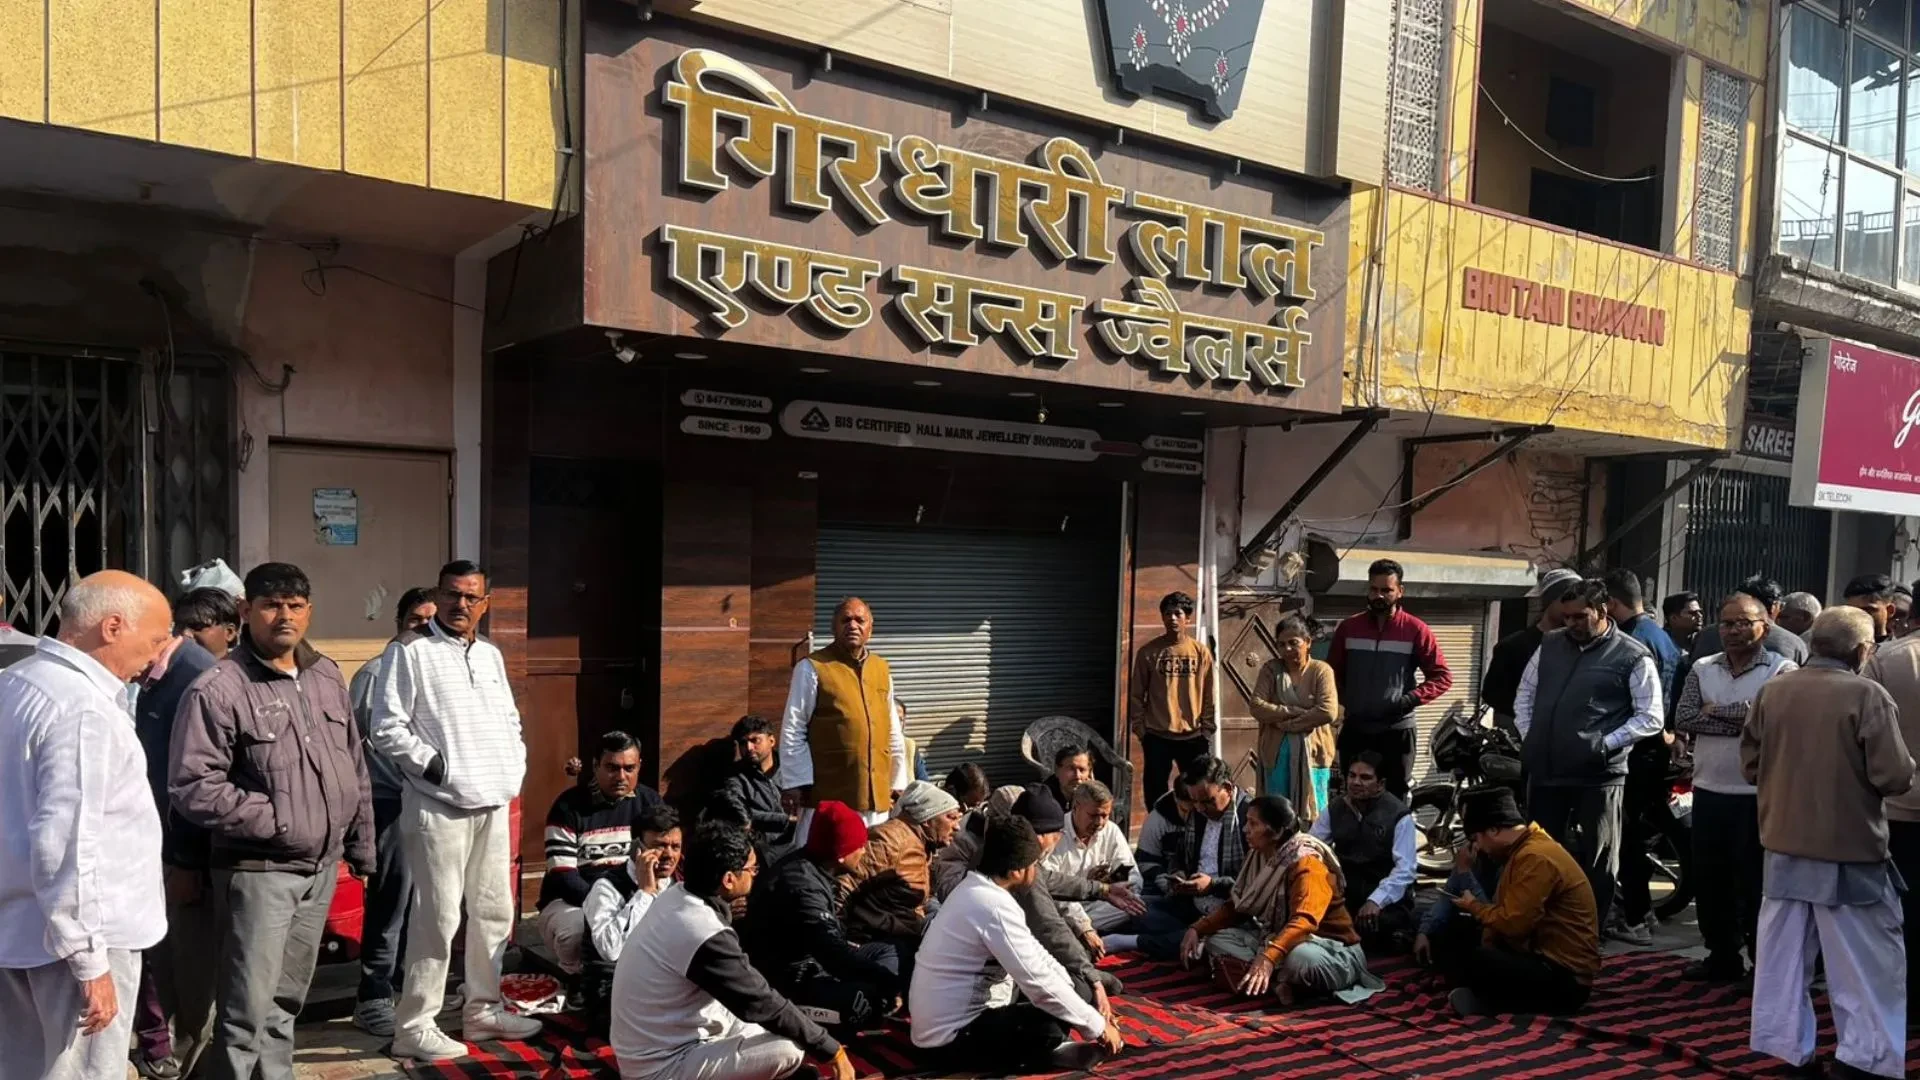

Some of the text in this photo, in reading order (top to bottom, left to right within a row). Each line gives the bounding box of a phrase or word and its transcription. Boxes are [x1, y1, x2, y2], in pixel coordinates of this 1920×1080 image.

[1129, 191, 1324, 301] लाल
[661, 223, 882, 328] एण्ड
[893, 264, 1086, 360] सन्स
[1567, 290, 1666, 346] BHAWAN
[697, 419, 730, 433] SINCE
[834, 415, 1086, 450] BIS CERTIFIED HALL MARK JEWELLERY SHOWROOM
